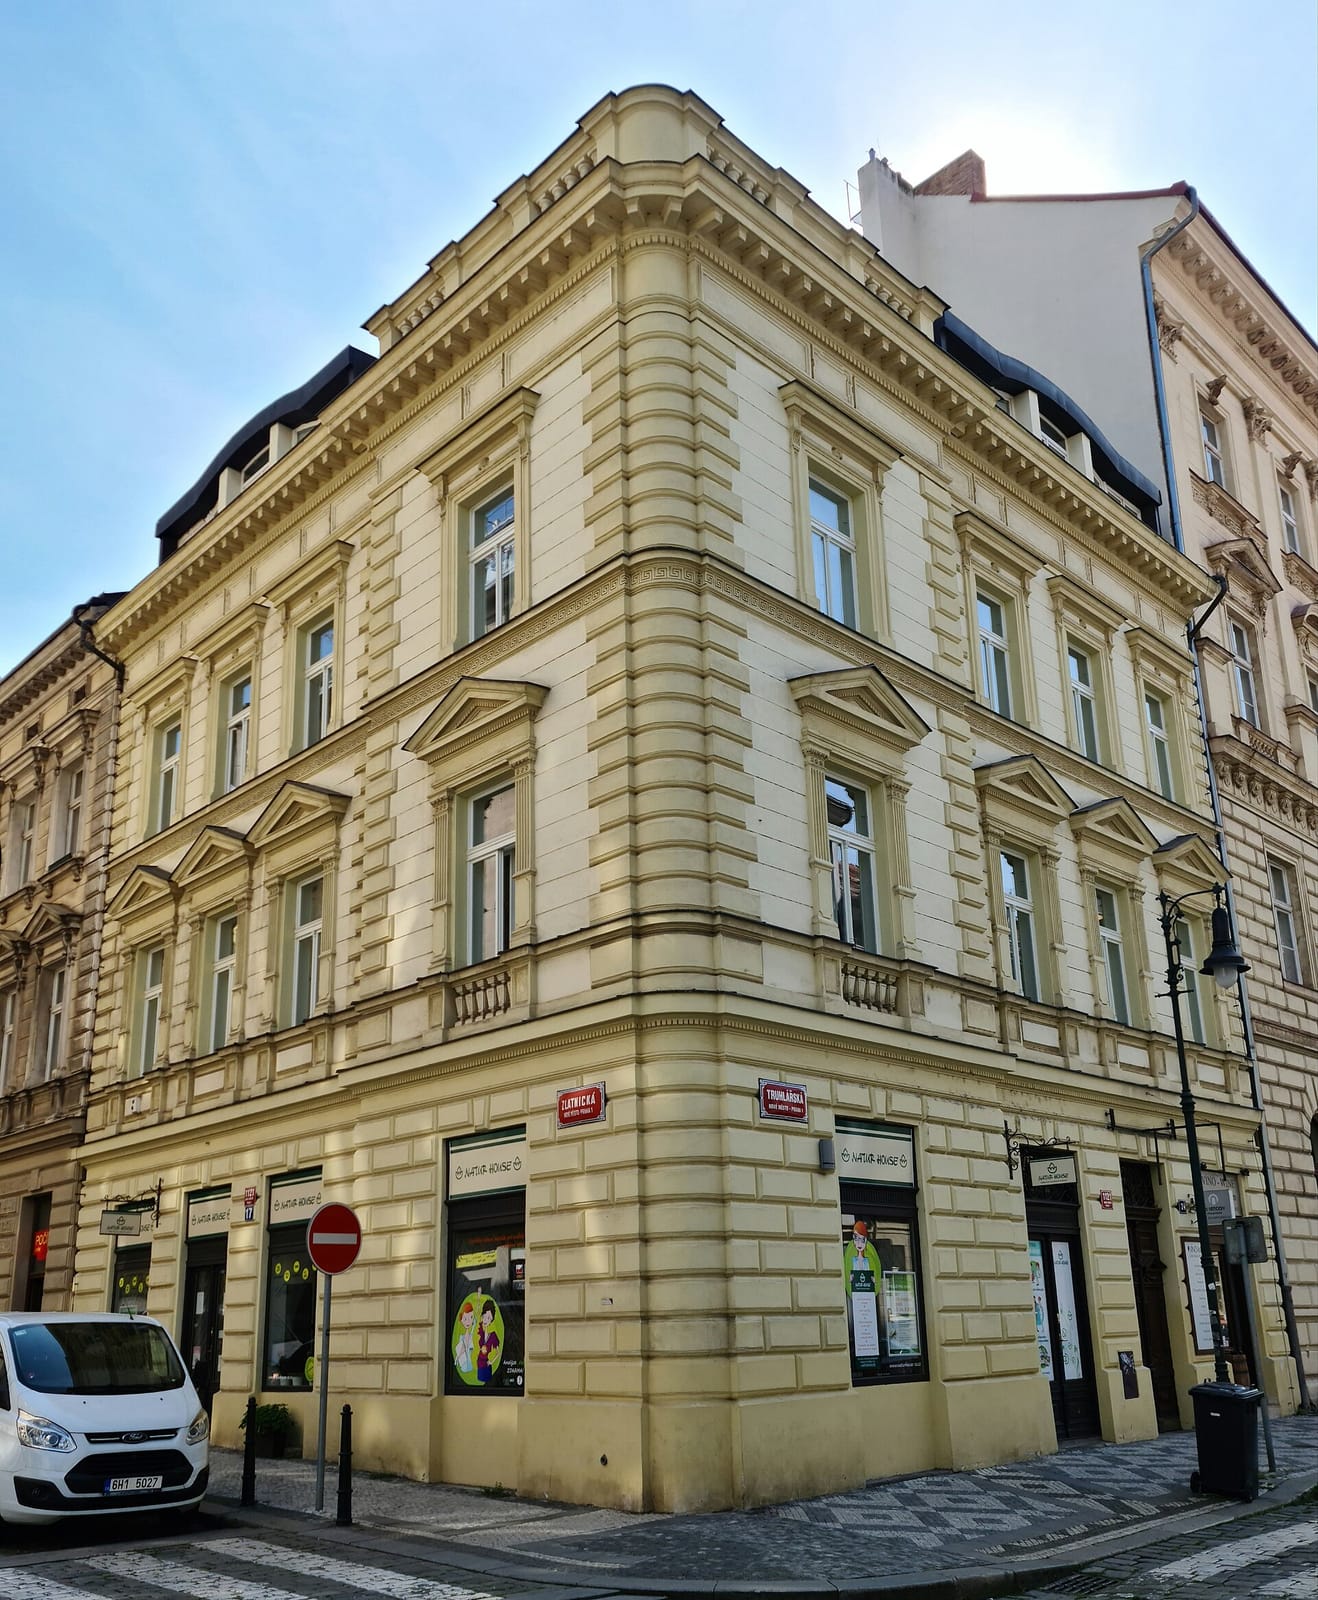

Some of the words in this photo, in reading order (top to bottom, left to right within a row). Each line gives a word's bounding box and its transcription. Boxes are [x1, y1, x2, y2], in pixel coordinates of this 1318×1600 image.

[561, 1091, 596, 1111] ZLATNICKÁ
[767, 1089, 804, 1104] TRUHLÁŘSKÁ
[852, 1152, 875, 1164] NATUR
[877, 1154, 899, 1166] HOUSE
[464, 1165, 488, 1178] NATUR
[489, 1161, 512, 1174] HOUSE
[280, 1198, 298, 1209] NATUR
[245, 1207, 253, 1219] 17
[112, 1479, 129, 1490] 6H1
[135, 1477, 158, 1489] 5027
